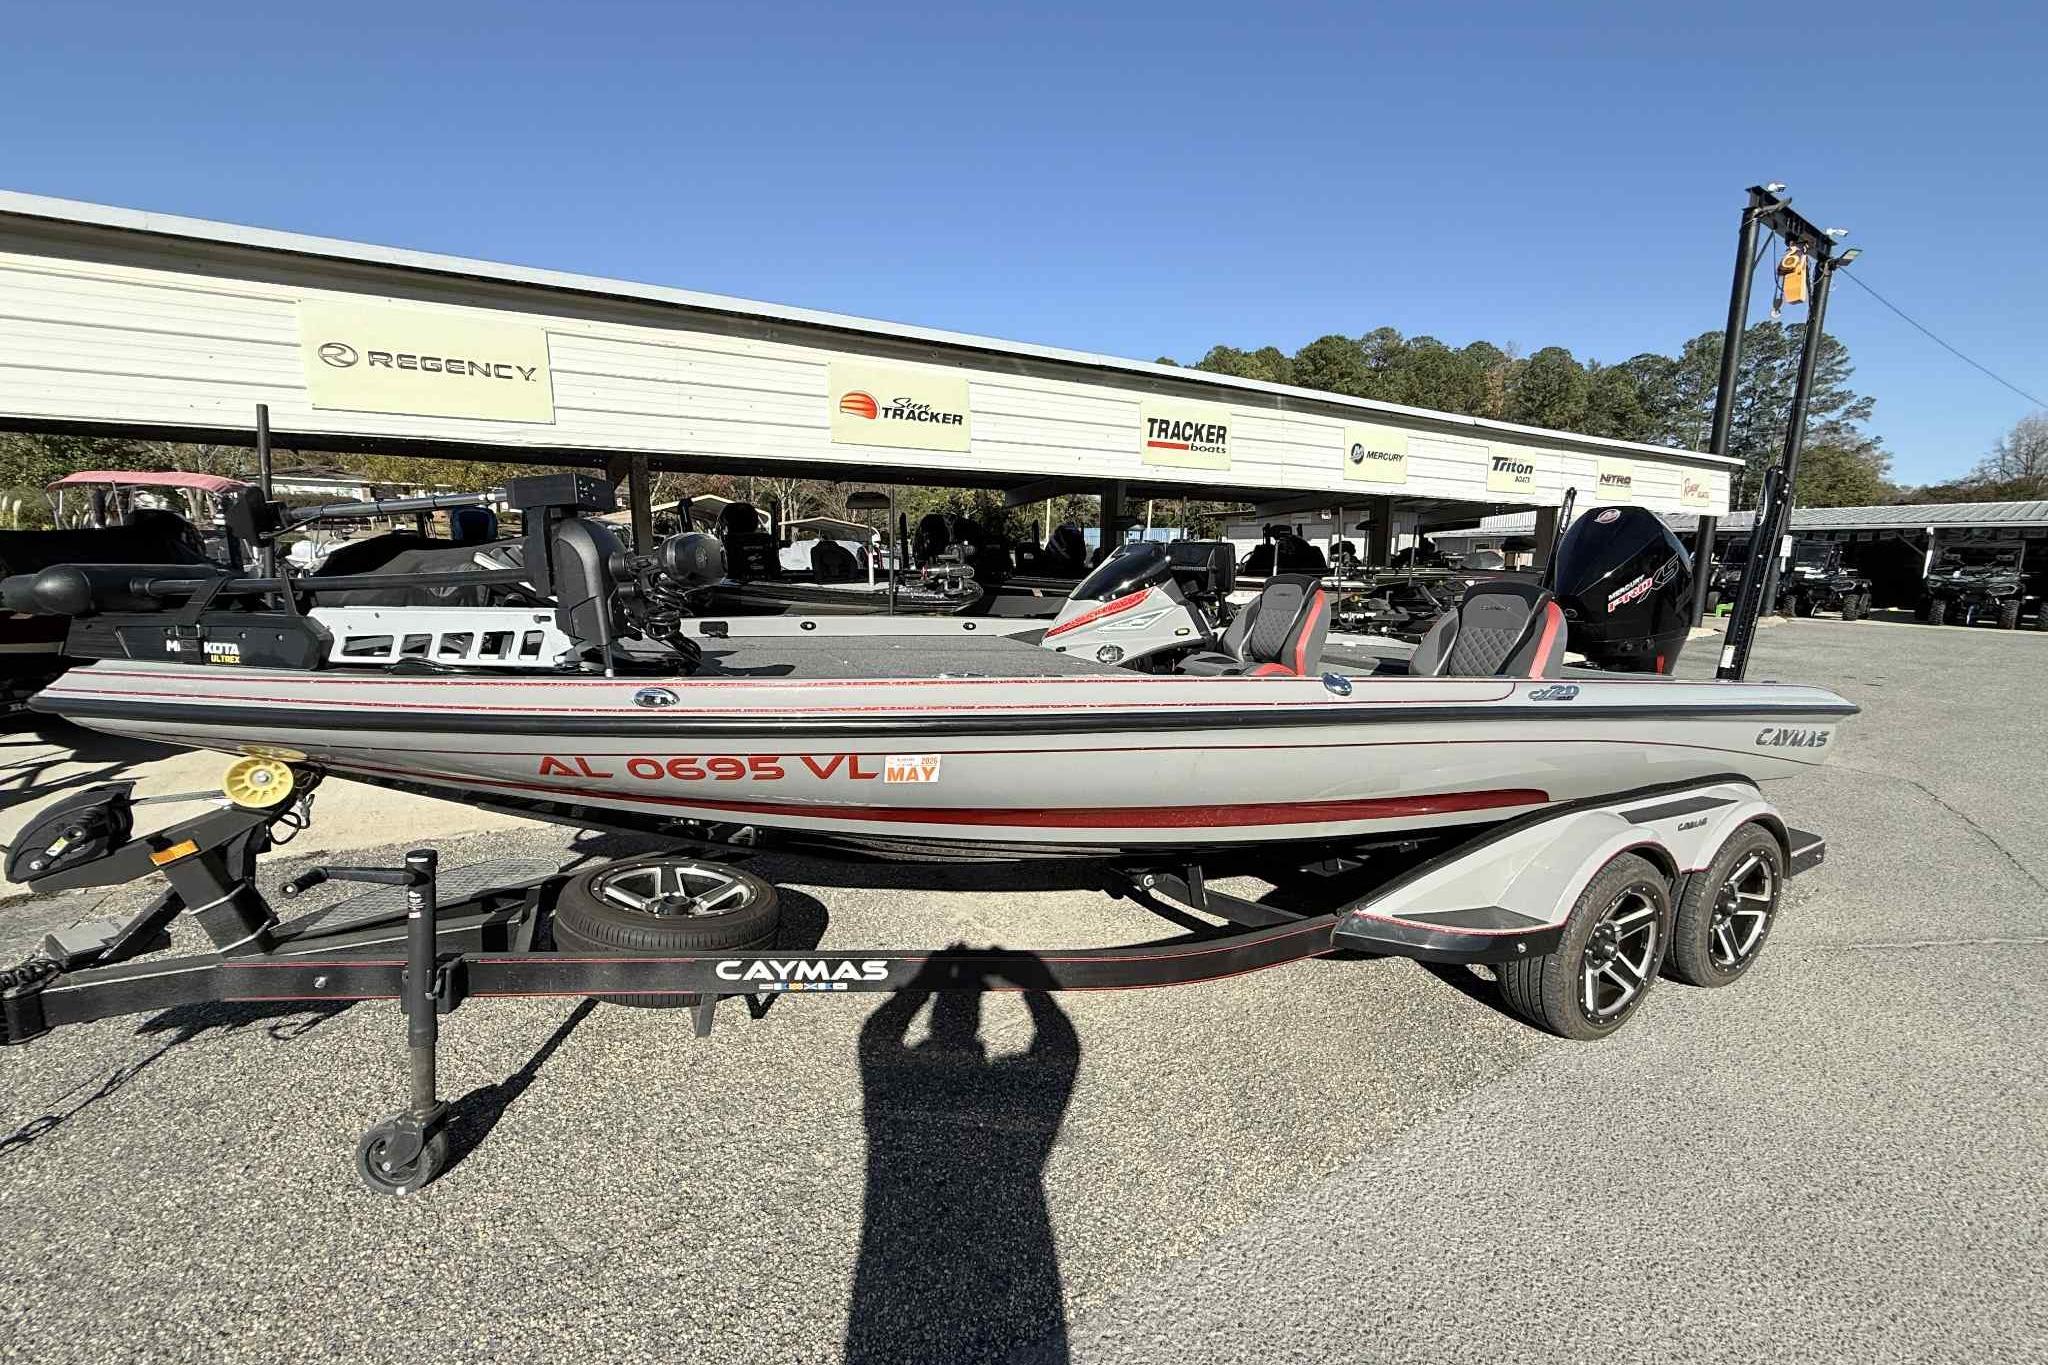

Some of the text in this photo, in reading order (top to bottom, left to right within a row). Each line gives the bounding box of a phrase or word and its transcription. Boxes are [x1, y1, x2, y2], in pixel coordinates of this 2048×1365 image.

[367, 350, 537, 382] REGENCY
[892, 397, 931, 411] Sun
[882, 407, 964, 426] TRACKER
[1147, 417, 1227, 445] TRACKER
[1190, 442, 1226, 454] boats
[1366, 450, 1404, 462] MERCURY
[1492, 456, 1534, 474] Triton
[203, 641, 240, 655] KOTA
[210, 654, 241, 664] ULTREX
[1755, 727, 1830, 748] CAYMAS
[539, 755, 880, 781] AL 0695 VL
[887, 766, 936, 782] MAY
[715, 960, 889, 981] CAYMAS
